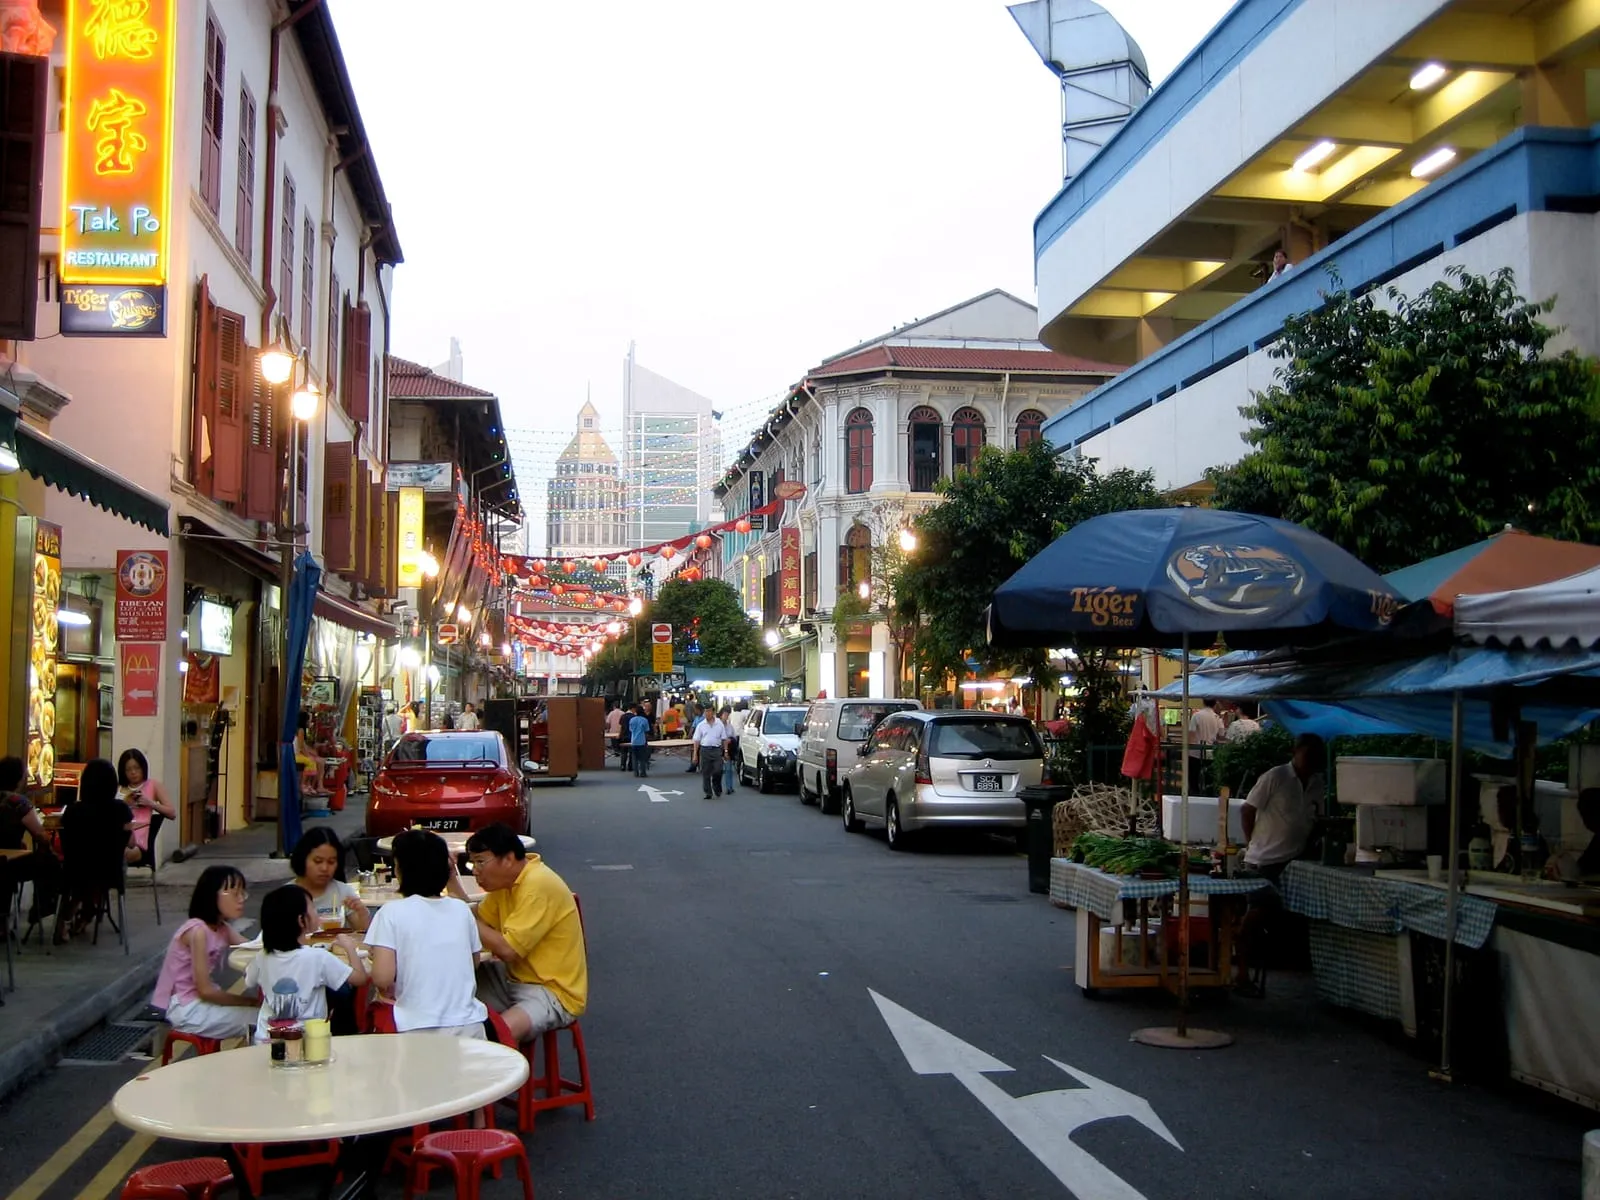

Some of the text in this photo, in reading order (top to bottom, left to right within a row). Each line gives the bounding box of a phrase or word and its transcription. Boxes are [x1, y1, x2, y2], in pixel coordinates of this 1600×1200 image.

[69, 205, 160, 236] Tak Po
[66, 252, 159, 267] RESTAURANT
[63, 288, 110, 312] Tiger
[1070, 586, 1138, 626] Tiger
[1112, 615, 1135, 626] Beer
[443, 820, 459, 829] 277
